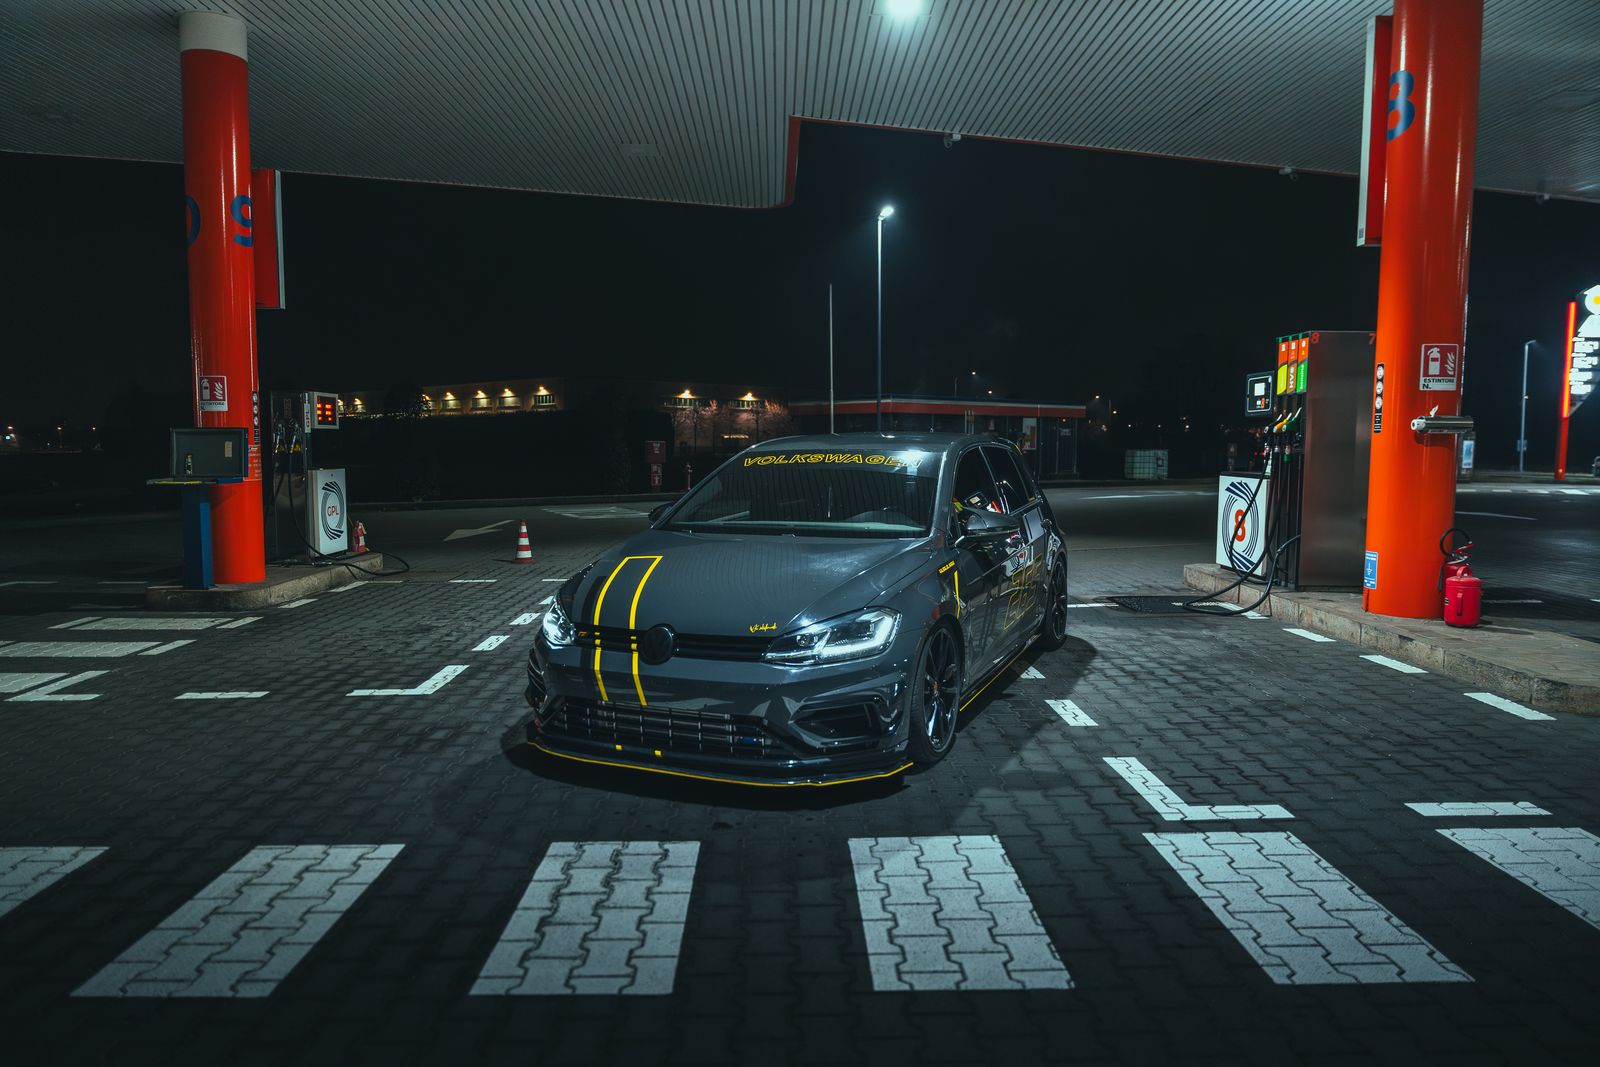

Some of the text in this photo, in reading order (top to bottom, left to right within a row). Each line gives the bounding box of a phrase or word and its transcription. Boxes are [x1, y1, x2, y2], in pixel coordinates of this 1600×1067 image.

[742, 453, 924, 468] VOLKSWAGEN
[327, 505, 340, 516] GPL
[1234, 509, 1246, 542] 8
